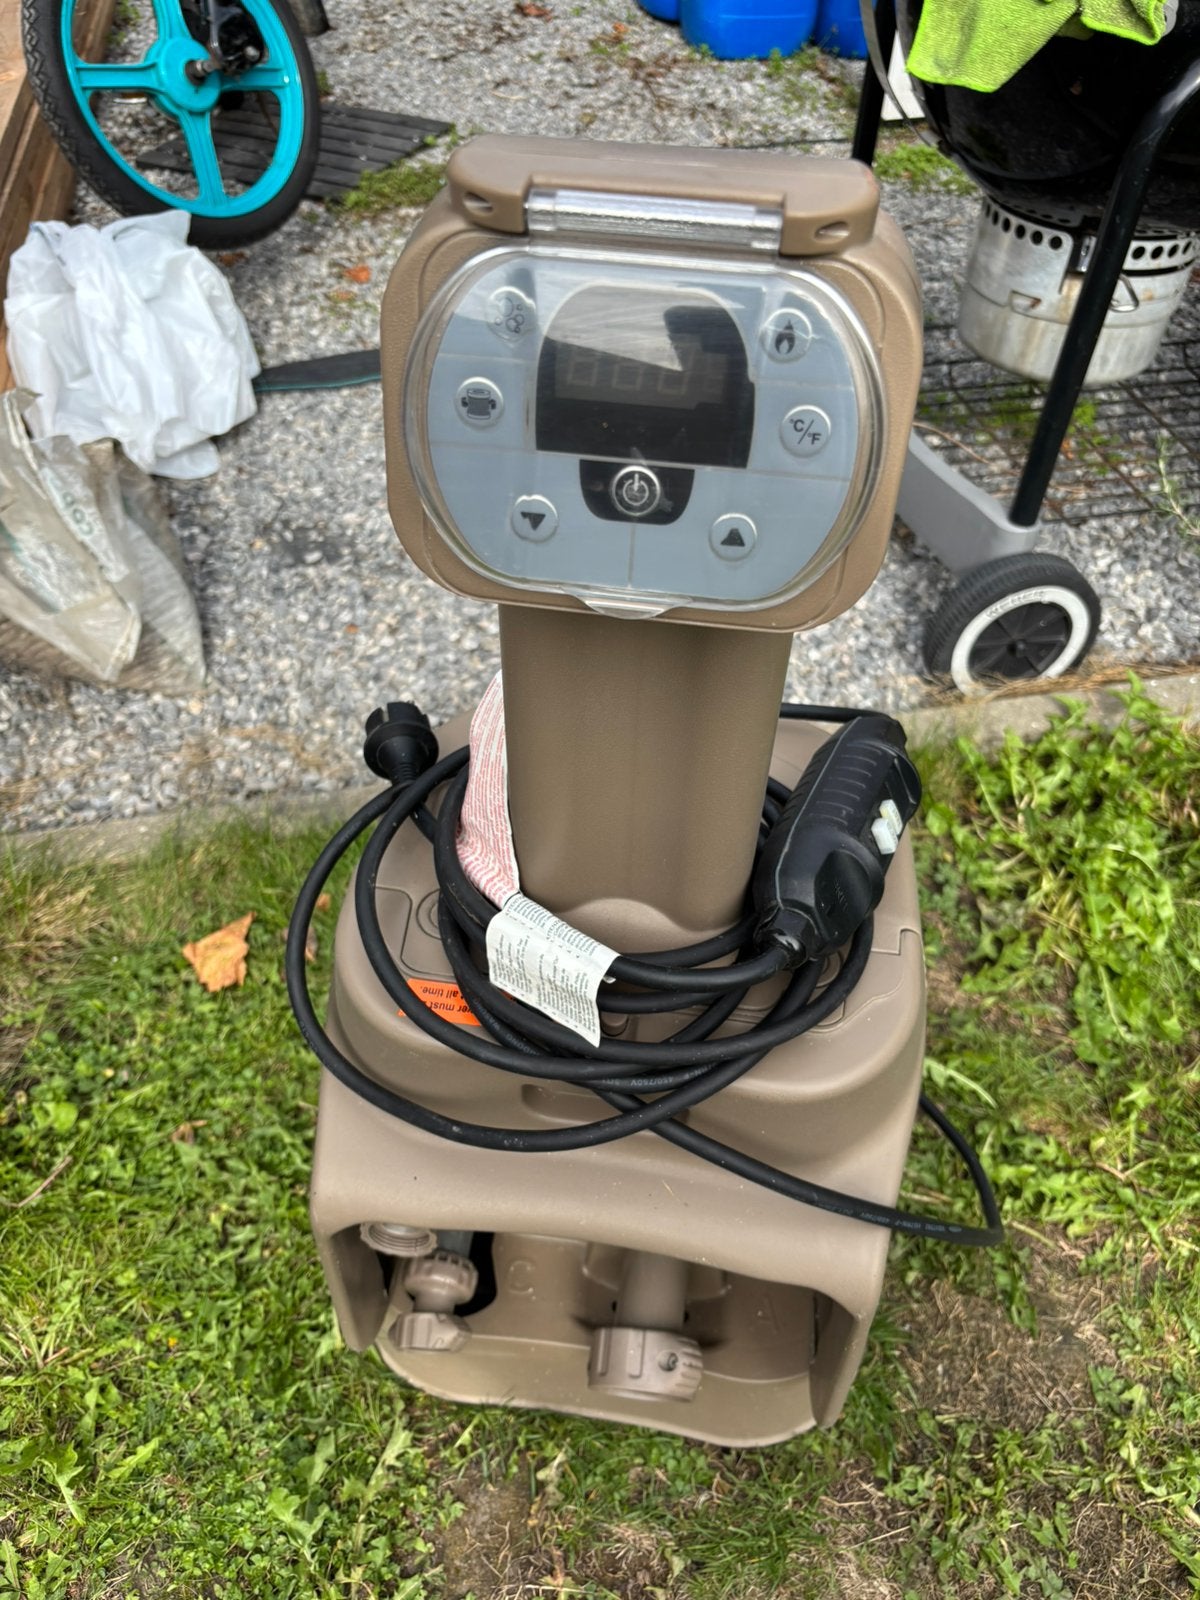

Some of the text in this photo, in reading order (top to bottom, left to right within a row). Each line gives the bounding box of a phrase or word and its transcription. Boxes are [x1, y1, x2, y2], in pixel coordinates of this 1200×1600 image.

[420, 985, 459, 999] all time.
[430, 1001, 455, 1011] must
